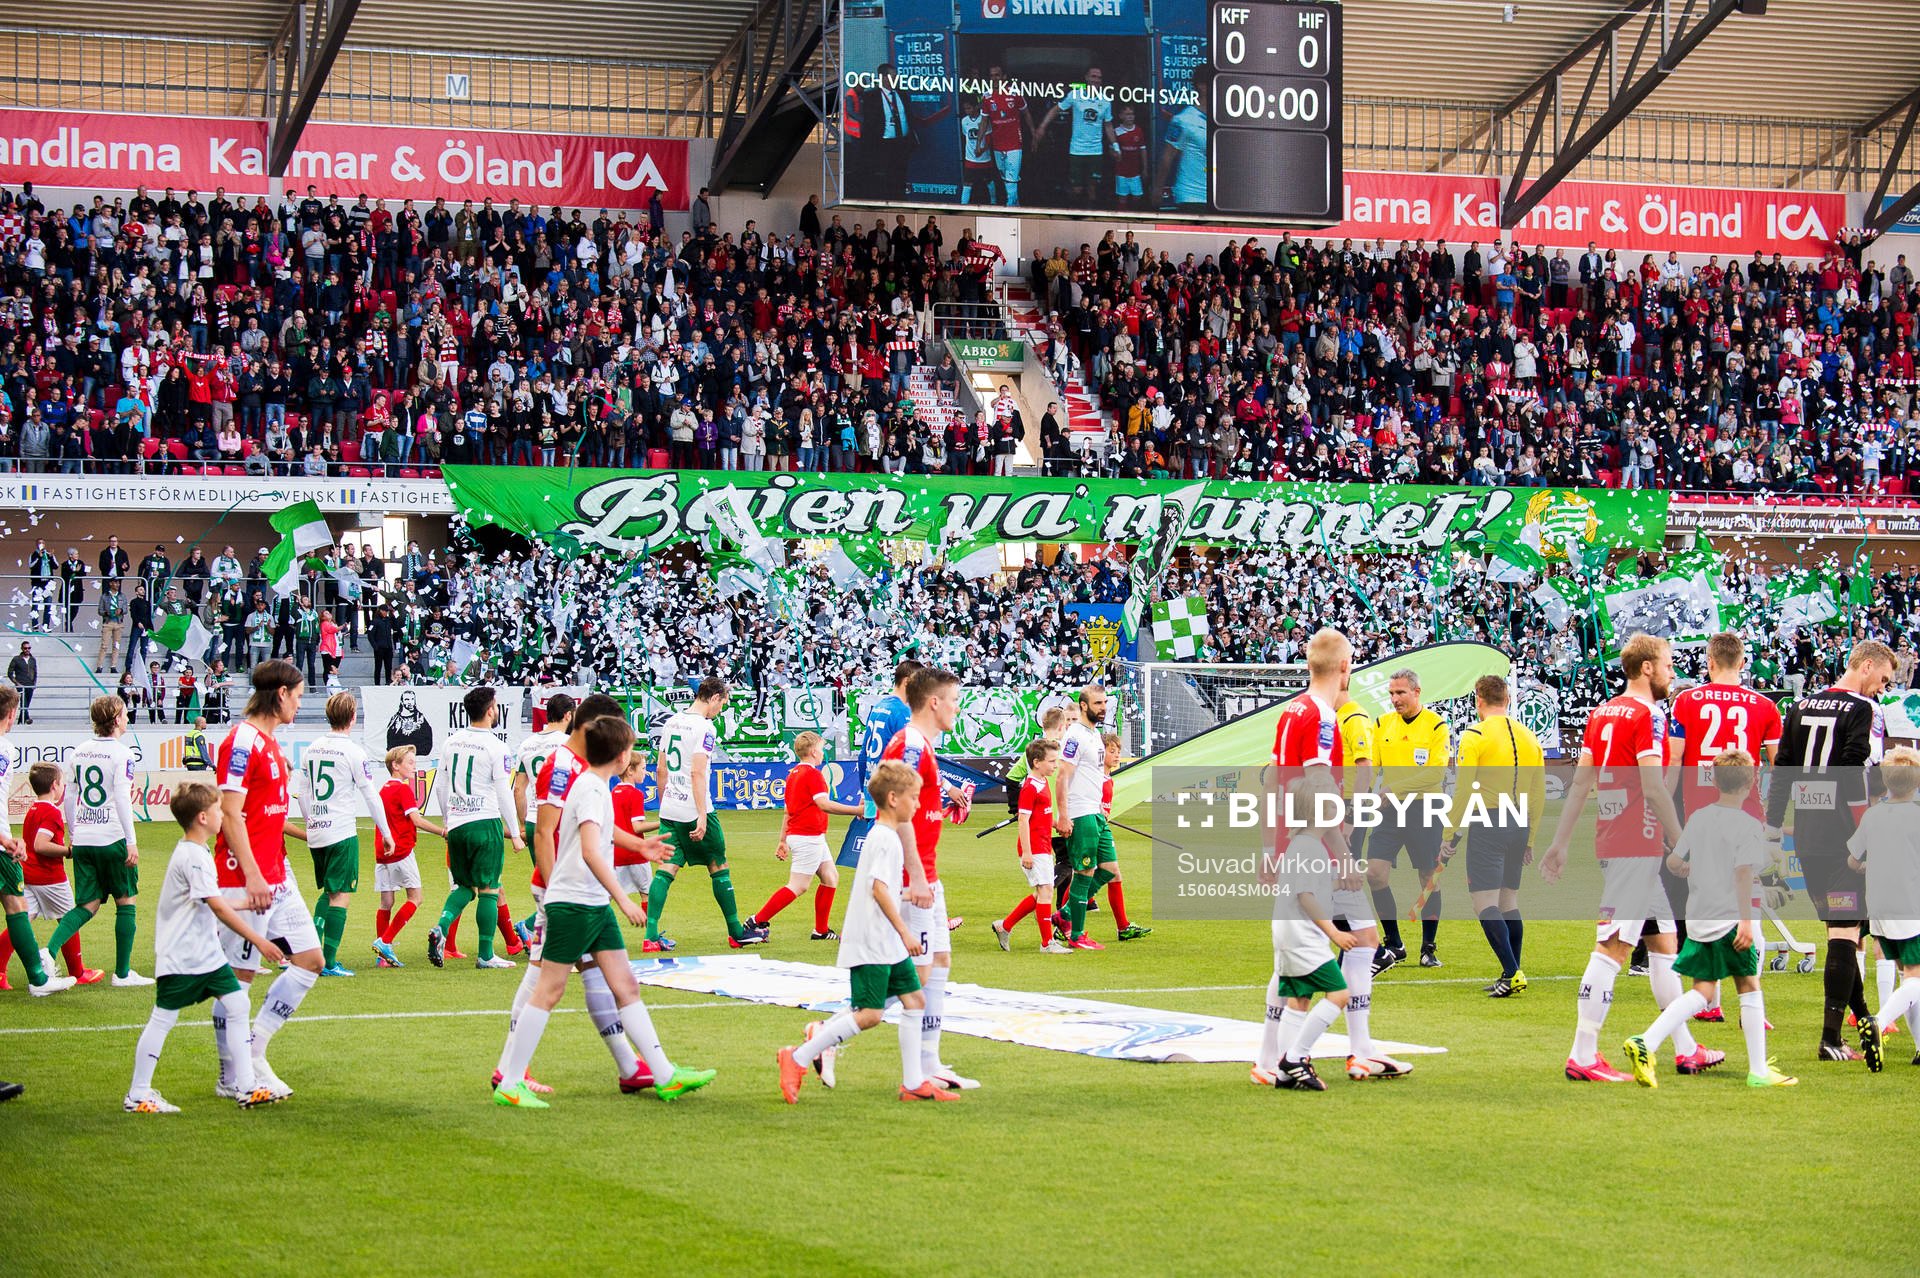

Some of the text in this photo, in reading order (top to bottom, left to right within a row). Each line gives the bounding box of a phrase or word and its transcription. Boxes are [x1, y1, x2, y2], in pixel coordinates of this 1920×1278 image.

[1220, 8, 1326, 30] KFF HIF
[897, 53, 943, 64] SVERIGES
[907, 41, 932, 52] HELA
[1174, 44, 1199, 55] HELA
[1225, 31, 1246, 65] 0
[1298, 35, 1319, 69] 0
[447, 76, 468, 97] M
[845, 71, 1201, 106] OCH VECKAN KAN KÄNNAS TUNG OCH SVÅR
[1225, 85, 1319, 121] 00:00
[391, 145, 425, 183] &
[437, 139, 563, 189] Öland
[594, 150, 667, 191] ICA
[1453, 191, 1590, 233] Kamar
[1600, 199, 1629, 233] &
[1638, 194, 1743, 239] Öland
[1766, 203, 1828, 241] ICA
[961, 345, 998, 357] ÅBRO
[43, 486, 260, 502] FASTIGHETSFÖRMEDLING
[271, 490, 336, 504] SVENSK
[361, 490, 455, 505] FASTIGHET
[1705, 690, 1758, 704] REDEYE
[1808, 699, 1854, 712] REDEYE
[1699, 703, 1749, 757] 23
[1800, 716, 1838, 774] 77
[666, 735, 682, 772] 5
[75, 764, 107, 808] 18
[309, 760, 335, 801] 15
[451, 753, 475, 796] 11
[1799, 791, 1833, 806] RASTA
